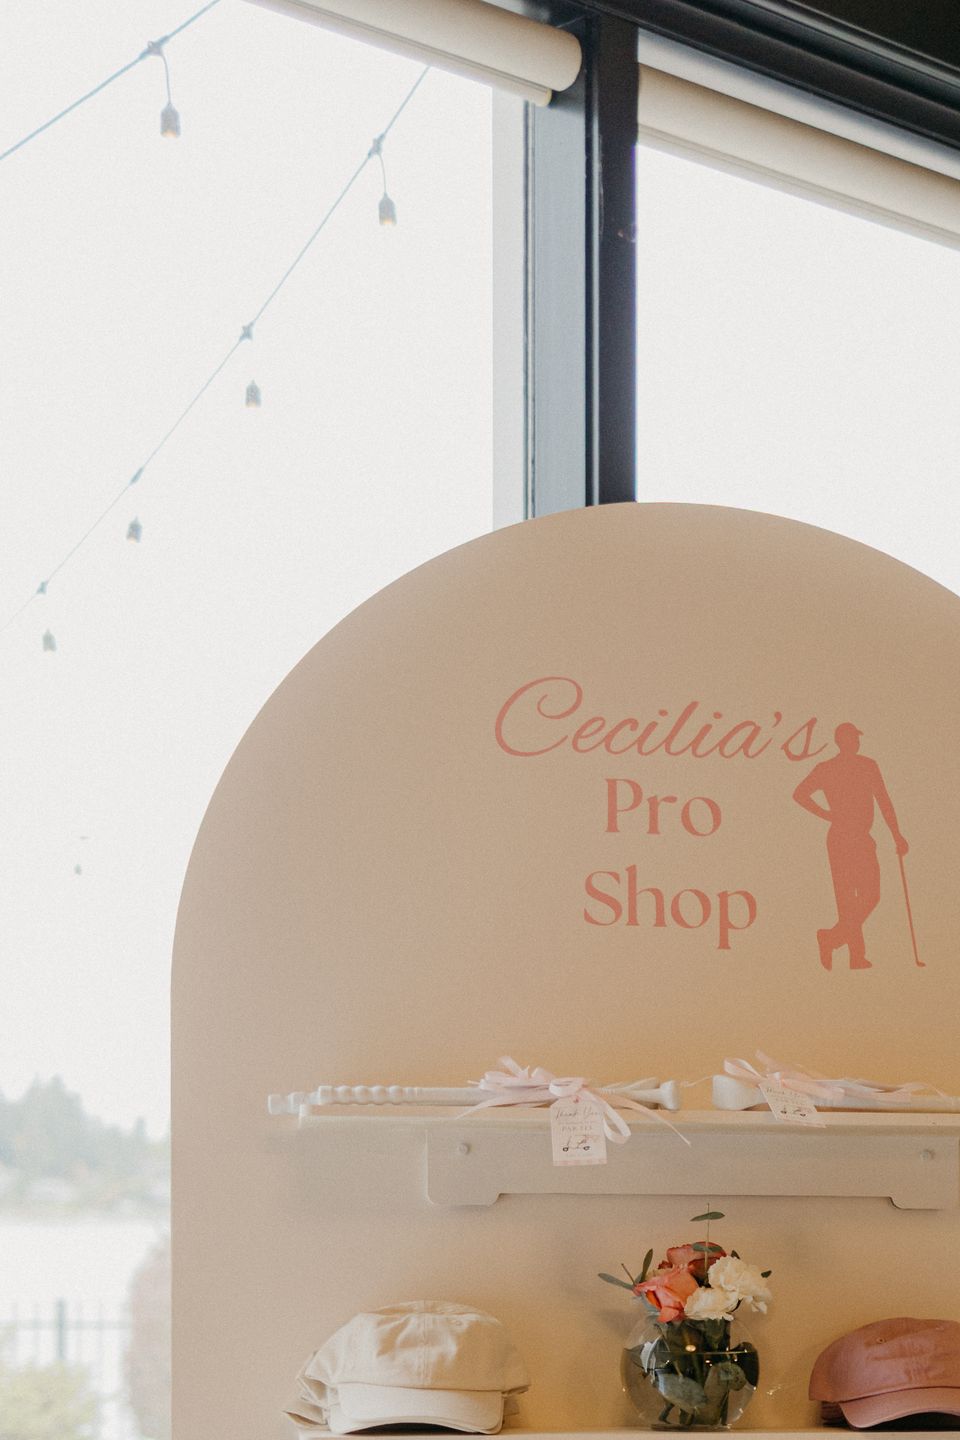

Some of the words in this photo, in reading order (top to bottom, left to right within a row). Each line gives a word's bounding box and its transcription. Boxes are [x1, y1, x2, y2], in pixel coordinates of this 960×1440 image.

[495, 676, 829, 762] Cecilia's
[604, 778, 722, 837] Pro
[583, 864, 757, 950] Shop
